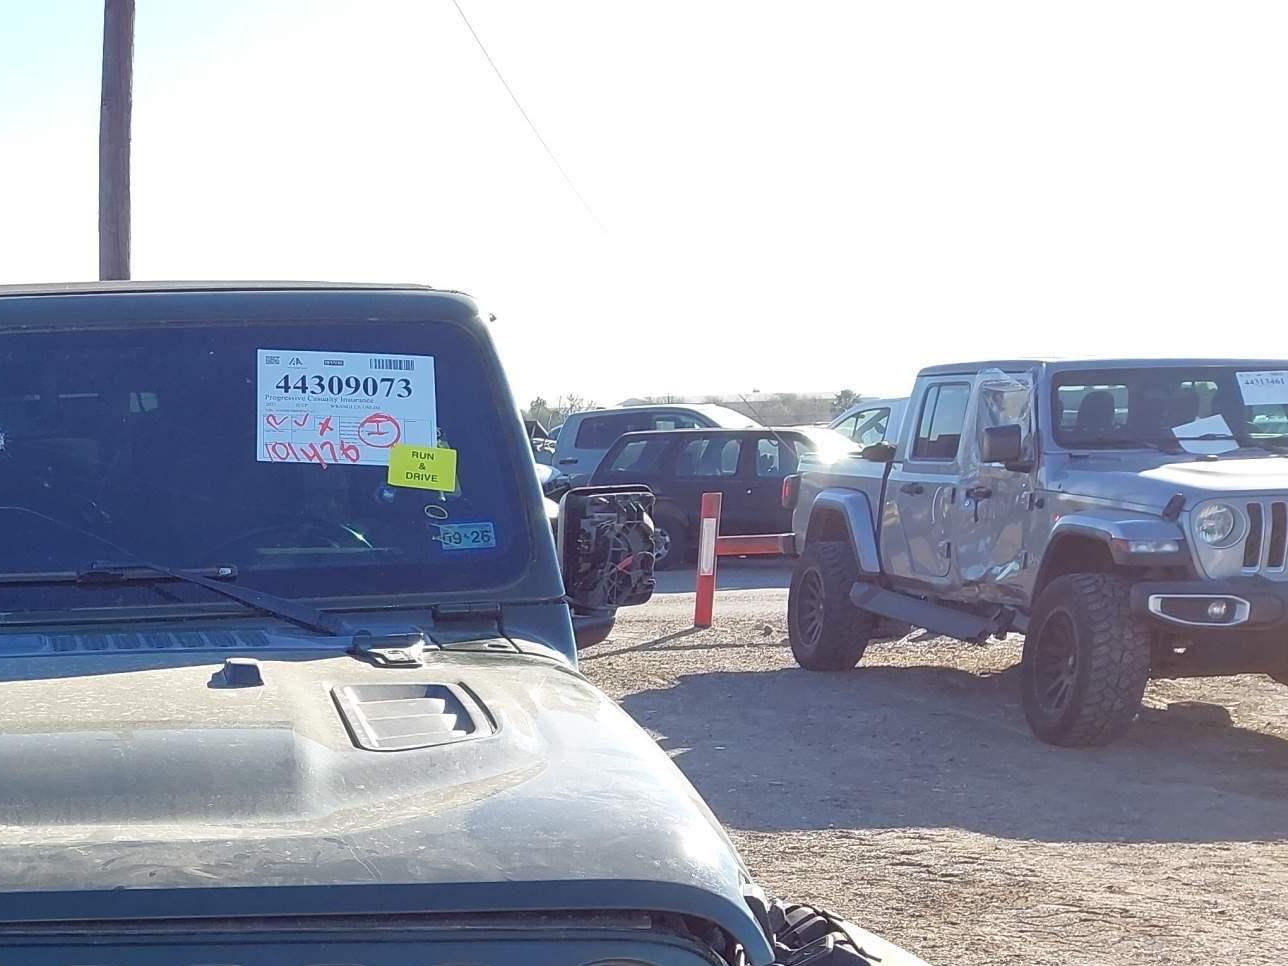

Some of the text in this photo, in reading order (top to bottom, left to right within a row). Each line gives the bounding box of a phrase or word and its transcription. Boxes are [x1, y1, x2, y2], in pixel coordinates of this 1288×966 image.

[275, 374, 413, 398] 44309073
[264, 394, 306, 403] Progressive
[411, 450, 435, 462] RUN
[418, 462, 427, 471] &
[405, 471, 439, 483] DRIVE
